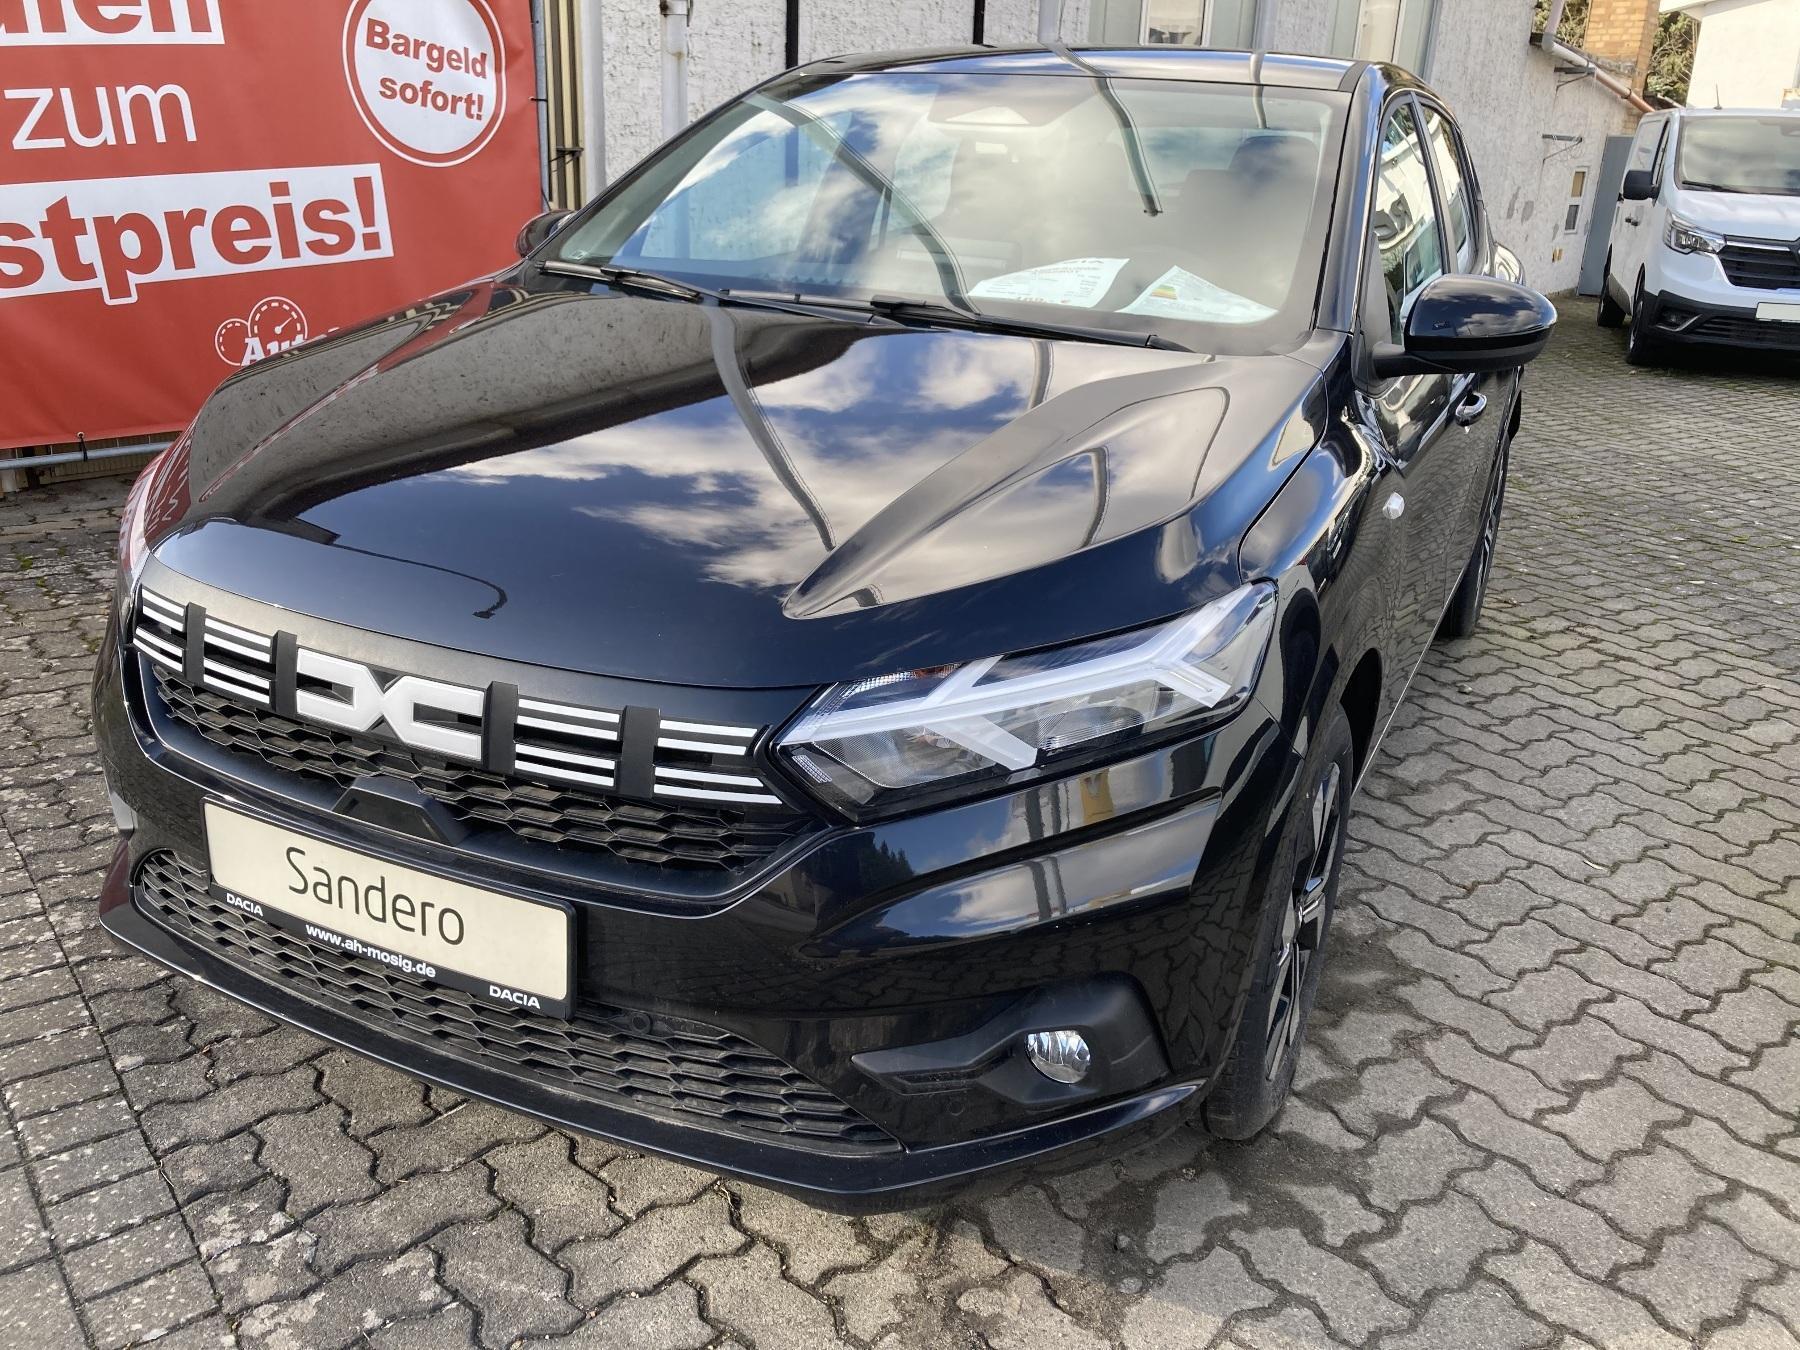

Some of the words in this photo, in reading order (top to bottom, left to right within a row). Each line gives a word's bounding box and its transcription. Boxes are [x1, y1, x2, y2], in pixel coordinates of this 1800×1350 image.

[366, 17, 487, 79] Bargeld
[4, 82, 197, 150] zum
[379, 77, 484, 120] sofort!
[226, 892, 264, 917] DACIA
[286, 846, 465, 946] Sandero
[306, 924, 436, 978] www.ah-mosig.de
[489, 985, 541, 1009] DACIA
